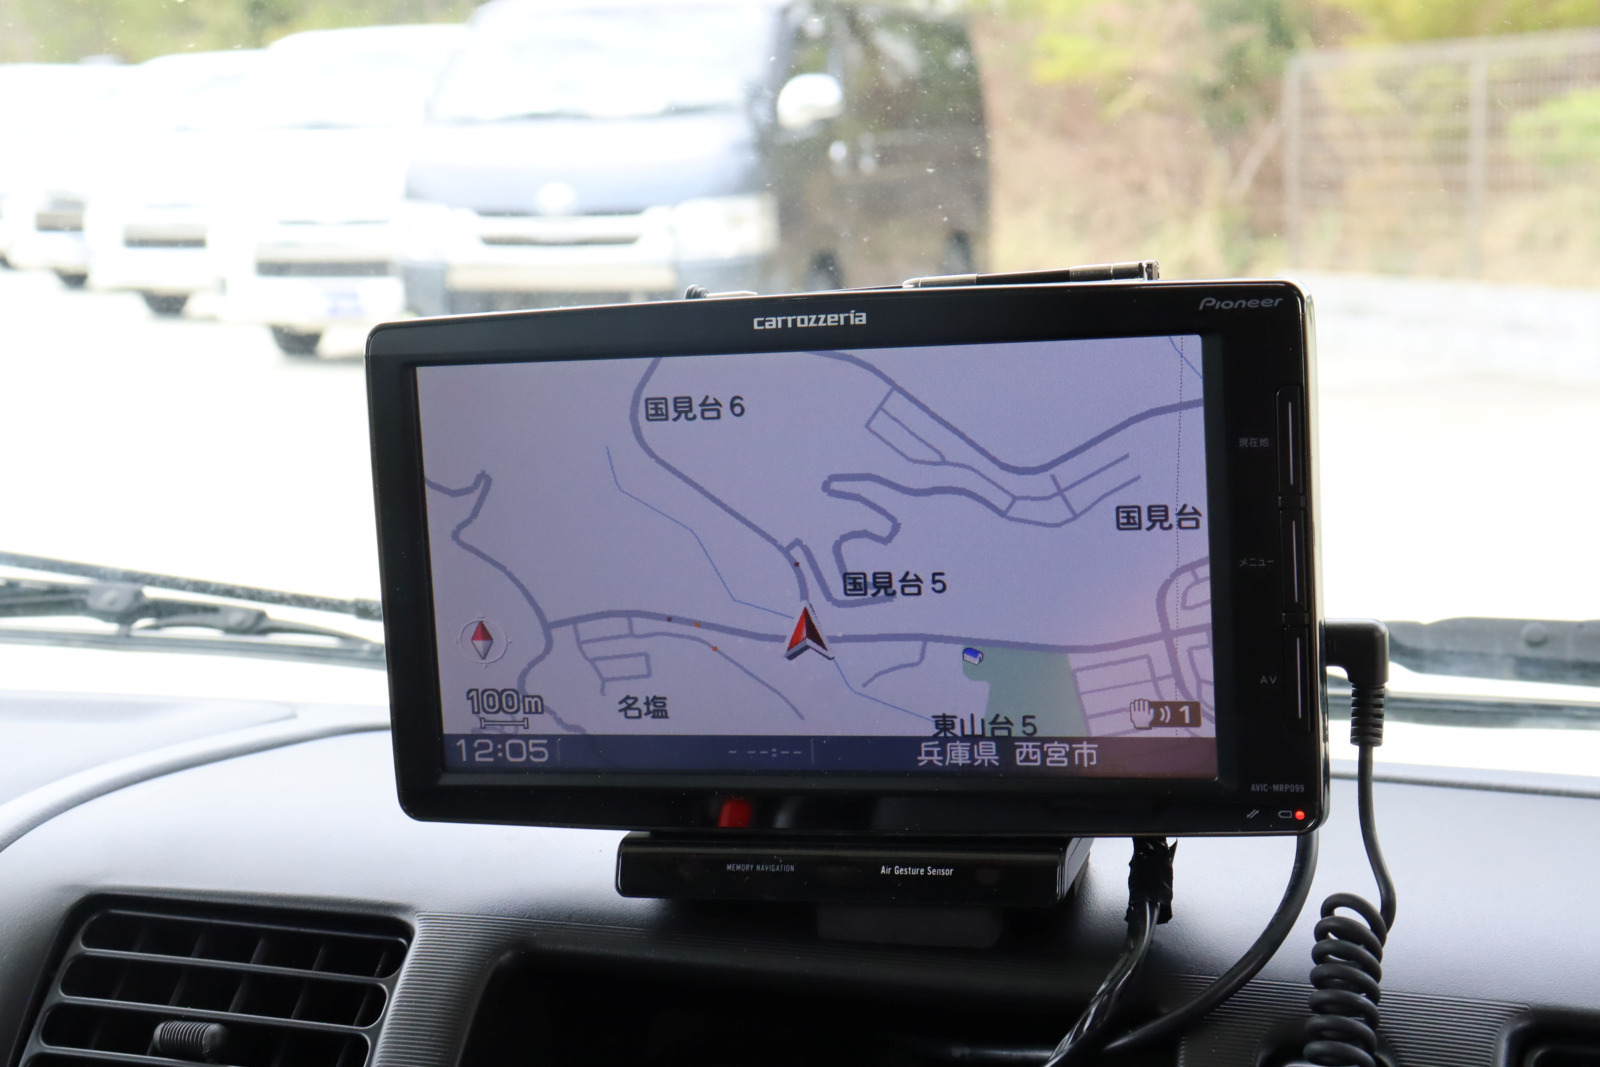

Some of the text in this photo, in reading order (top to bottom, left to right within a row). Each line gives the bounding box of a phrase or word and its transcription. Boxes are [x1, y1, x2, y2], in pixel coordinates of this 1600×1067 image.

[1198, 297, 1284, 310] Pioneer
[1115, 503, 1203, 532] 国見台
[1239, 557, 1275, 567] メニュー
[1260, 675, 1277, 684] AV
[466, 688, 545, 715] 100m
[617, 694, 670, 720] 名塩
[456, 739, 550, 762] 12:05
[917, 740, 1099, 767] 兵庫県 西宮市
[1250, 783, 1305, 793] AVIC-MRP099
[726, 863, 795, 872] MEMORY NAVIGATION
[880, 865, 954, 876] Air Gesture Sensor
